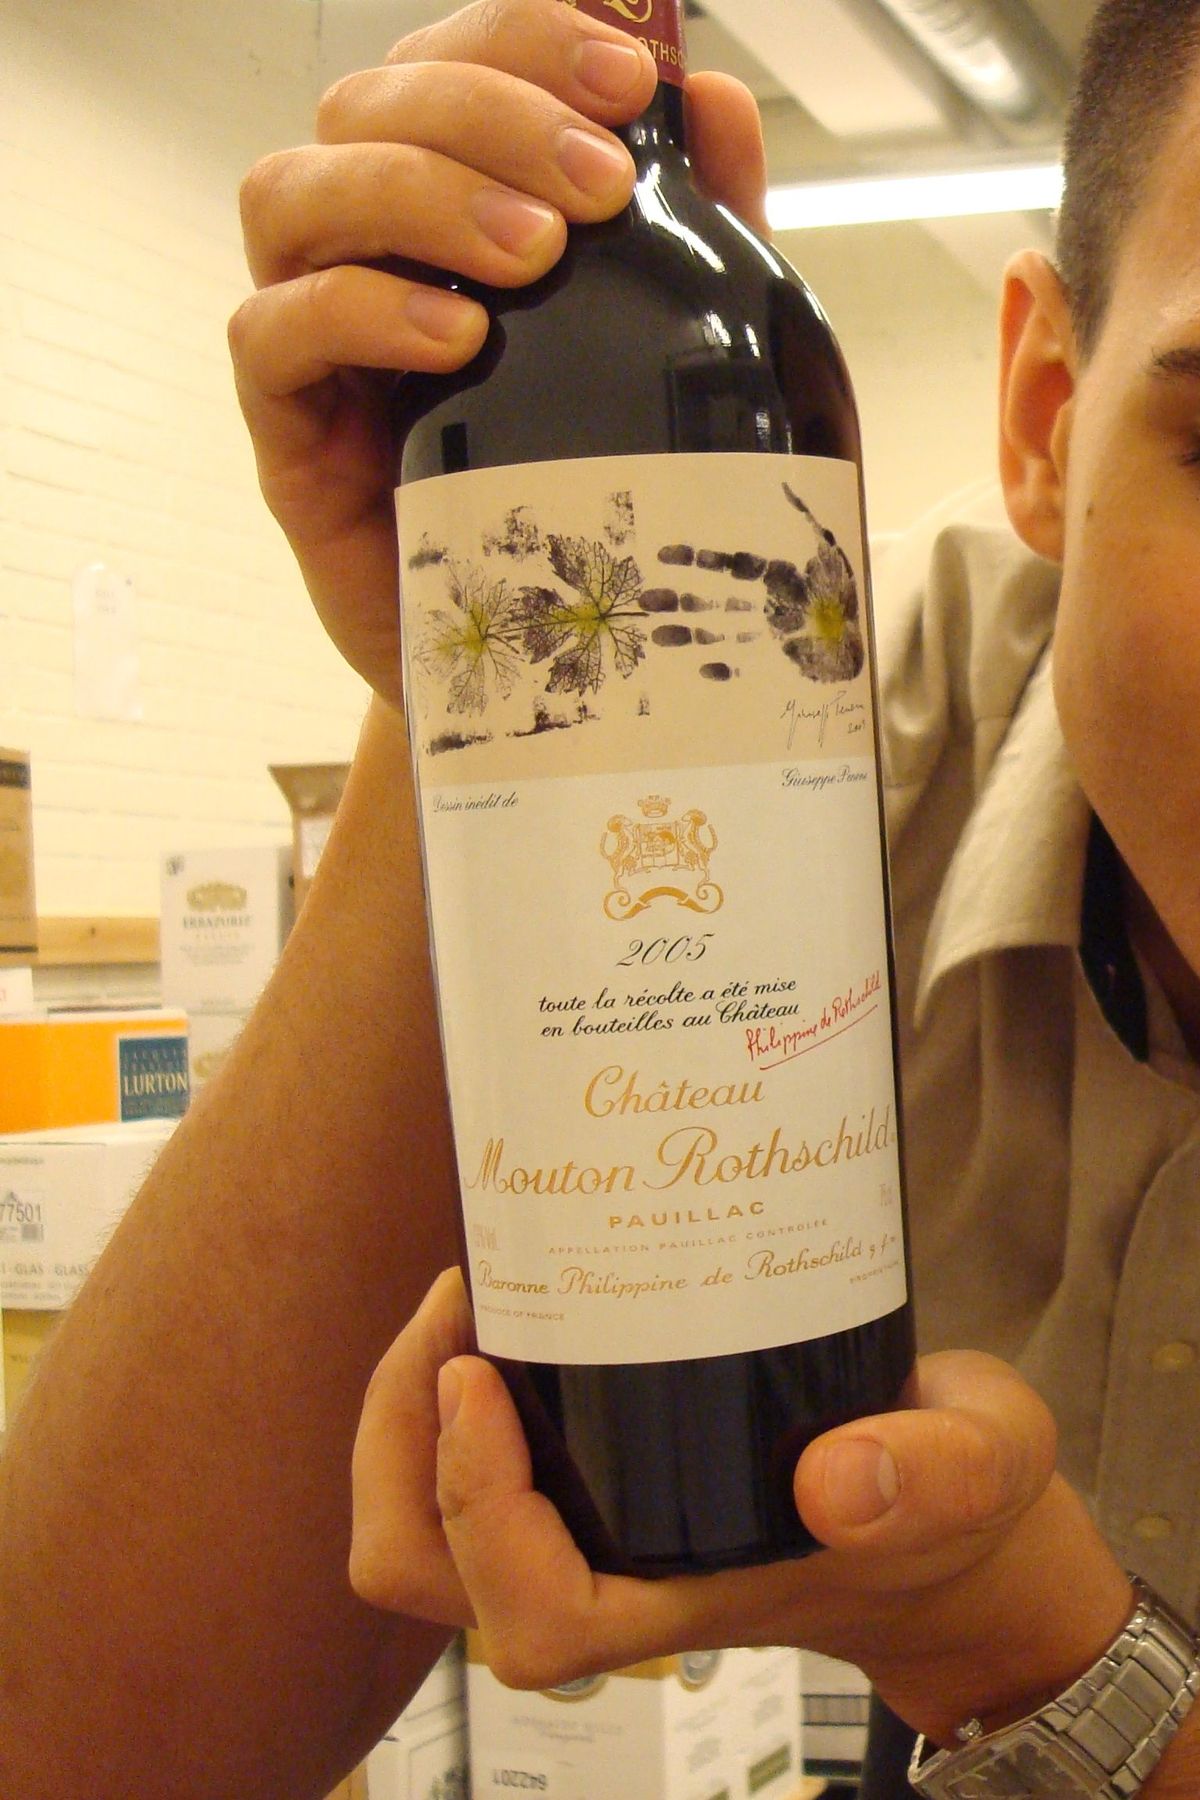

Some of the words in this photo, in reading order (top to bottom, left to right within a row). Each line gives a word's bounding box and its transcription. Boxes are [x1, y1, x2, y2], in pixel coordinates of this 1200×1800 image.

[782, 768, 836, 791] Giuseppe
[501, 791, 519, 808] de
[616, 933, 715, 967] 2005
[539, 995, 587, 1013] toute
[592, 987, 616, 1010] la
[626, 981, 696, 1007] récolte
[699, 988, 715, 1001] a
[719, 980, 749, 999] été
[754, 977, 797, 996] mise
[540, 1023, 565, 1038] en
[572, 1010, 674, 1036] bouteilles
[682, 1013, 712, 1027] au
[715, 999, 800, 1024] Château
[124, 1072, 189, 1096] LURTON
[584, 1064, 766, 1118] Château
[463, 1137, 636, 1195] Mouton
[642, 1103, 893, 1190] Rothschild
[608, 1201, 766, 1229] PAUILLAC
[547, 1243, 650, 1255] APPELLATION
[658, 1235, 738, 1251] PAUILLAC
[478, 1259, 551, 1295] Baronne
[556, 1265, 690, 1299] Philippine
[701, 1266, 734, 1287] de
[744, 1235, 864, 1281] Rothschild
